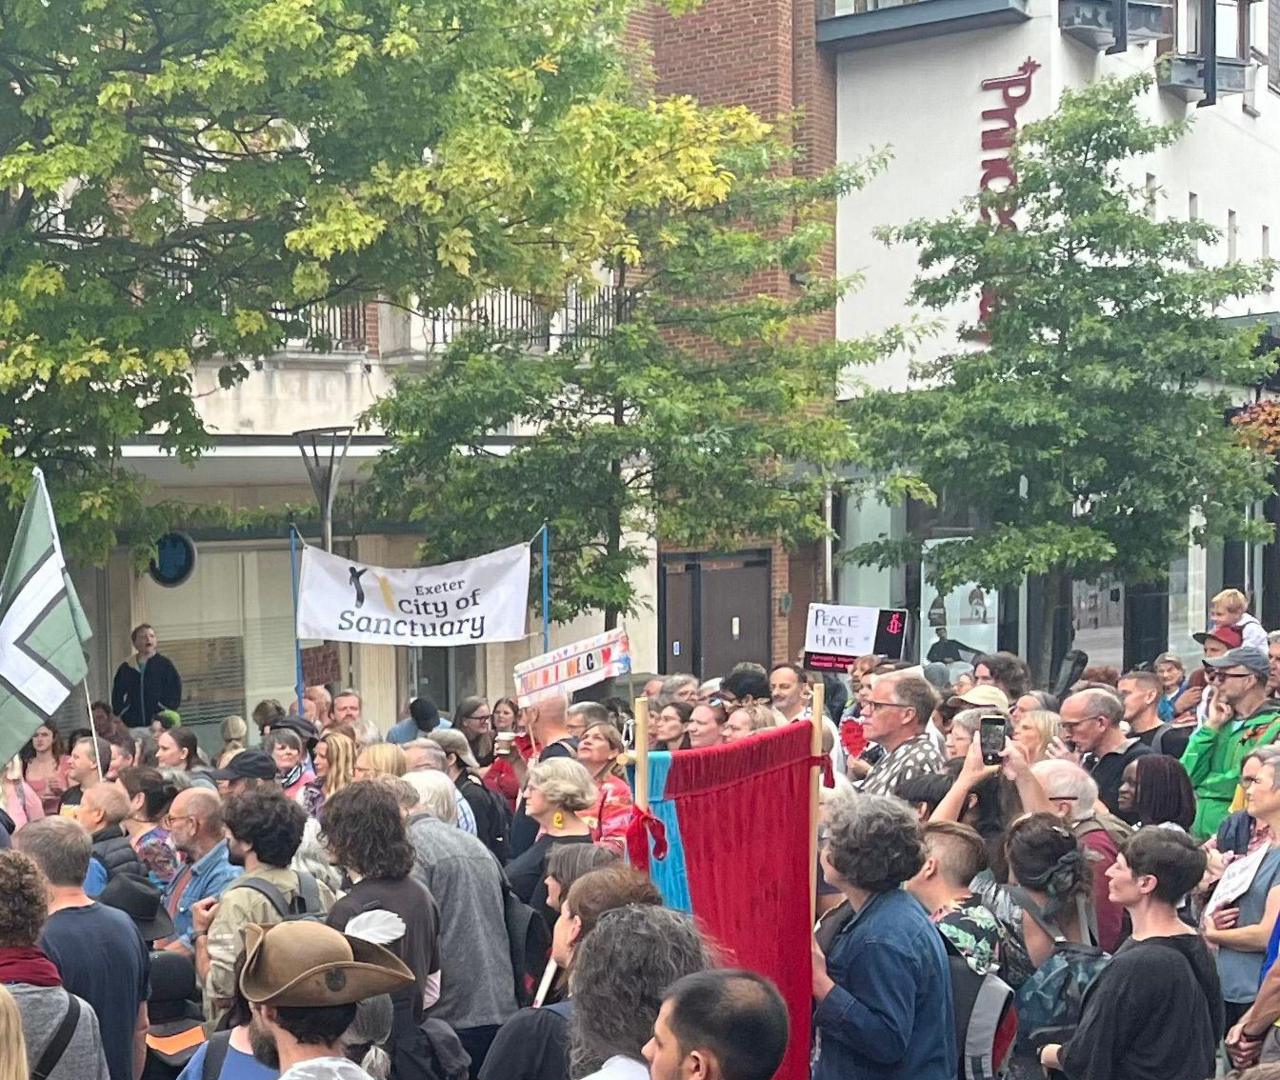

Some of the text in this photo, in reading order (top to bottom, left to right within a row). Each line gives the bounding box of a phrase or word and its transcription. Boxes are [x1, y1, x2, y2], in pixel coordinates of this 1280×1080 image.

[415, 578, 466, 597] Exeter
[398, 587, 482, 619] City of
[338, 609, 486, 640] Sanctuary
[815, 608, 860, 628] PEACE
[815, 634, 856, 648] HATE
